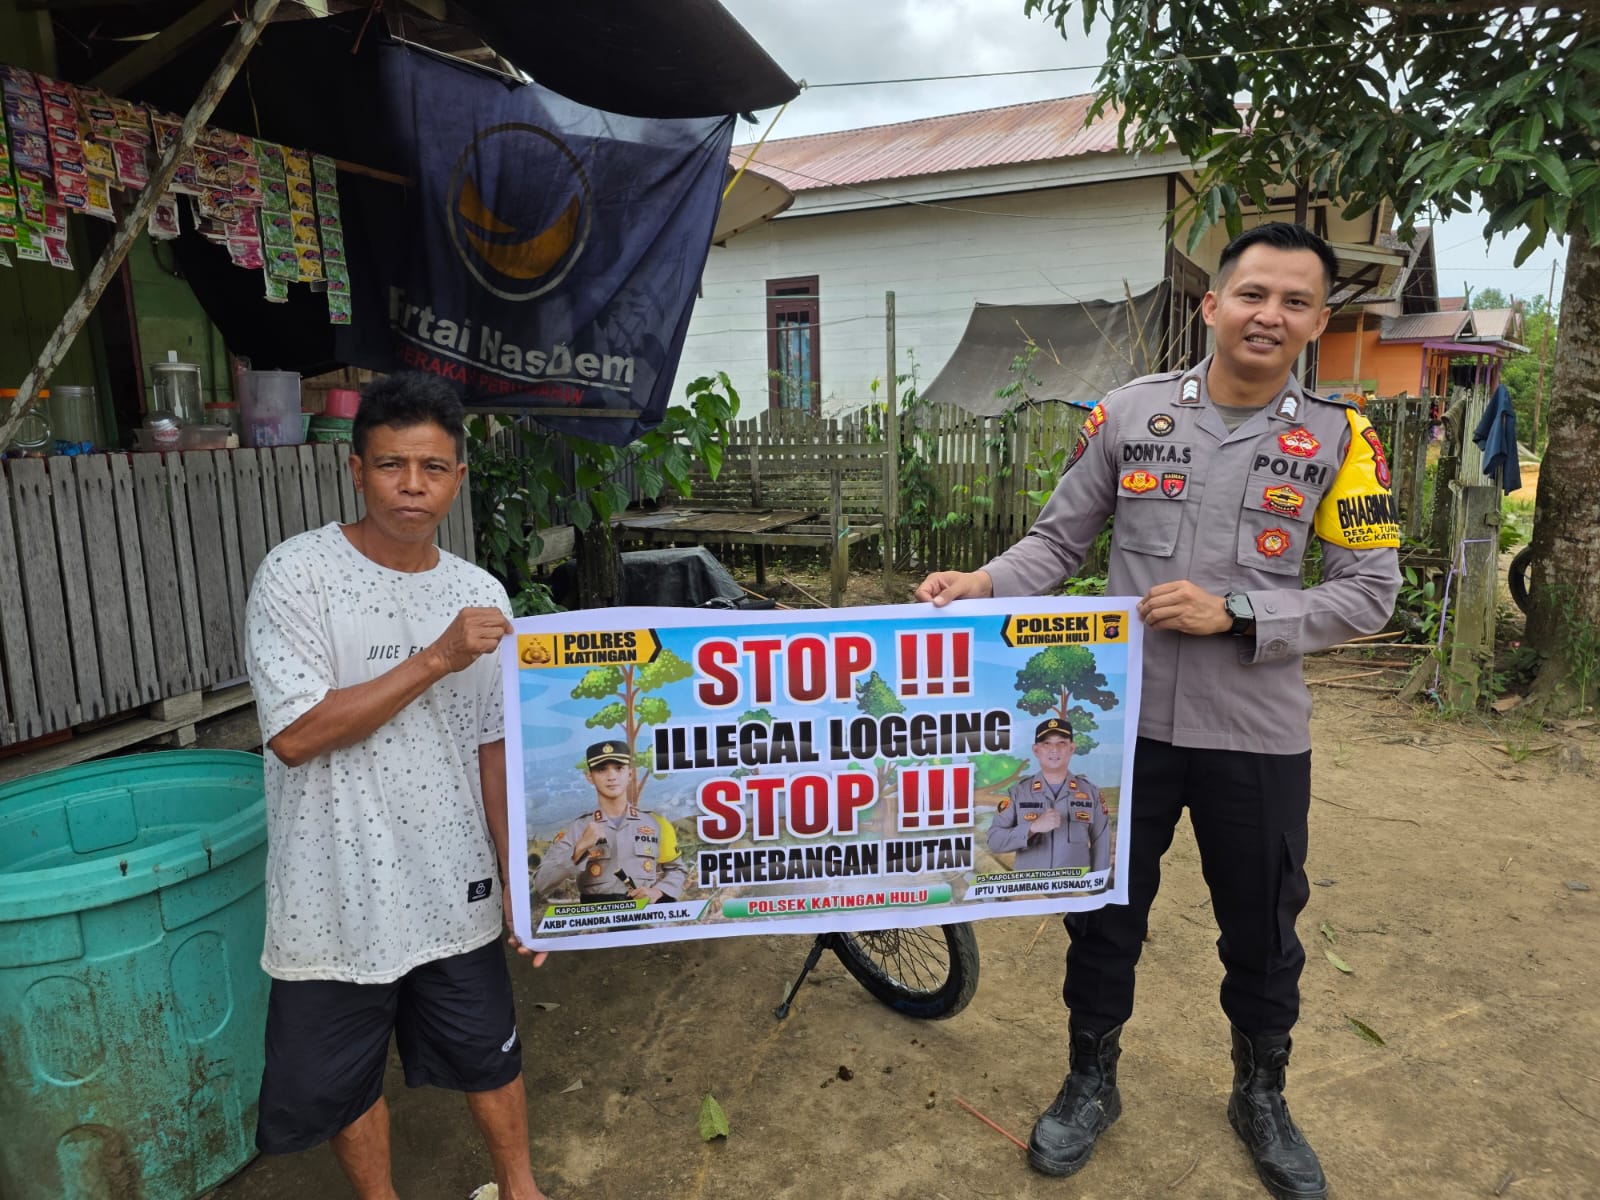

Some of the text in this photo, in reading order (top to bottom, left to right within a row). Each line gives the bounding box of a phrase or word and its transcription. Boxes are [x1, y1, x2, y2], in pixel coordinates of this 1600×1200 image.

[480, 325, 634, 383] NasDem
[1122, 443, 1192, 465] DONY.A.S
[1253, 454, 1329, 486] POLRI
[1348, 536, 1371, 544] KEC.
[1016, 616, 1090, 633] POLSEK
[564, 631, 637, 650] POLRES
[1016, 632, 1090, 645] KATINGAN HULU
[564, 650, 637, 665] KATINGAN
[696, 631, 970, 707] STOP !!!
[654, 710, 1012, 772] ILLEGAL LOGGING
[700, 766, 970, 842] STOP !!!
[634, 835, 658, 844] POLRI
[701, 836, 973, 885] PENEBANGAN HUTAN
[989, 873, 1024, 881] KAPOLSEK
[1025, 871, 1061, 879] KATINGAN
[1062, 869, 1082, 877] HULU
[974, 877, 1104, 896] IPTU YUBAMBANG KUSNADY, SH
[555, 902, 636, 915] KAPOLRES KATINGAN
[748, 889, 929, 914] POLSEK KATINGAN HULU
[543, 909, 691, 930] AKBP CHANDRA ISMAWANTO, S.I.K.
